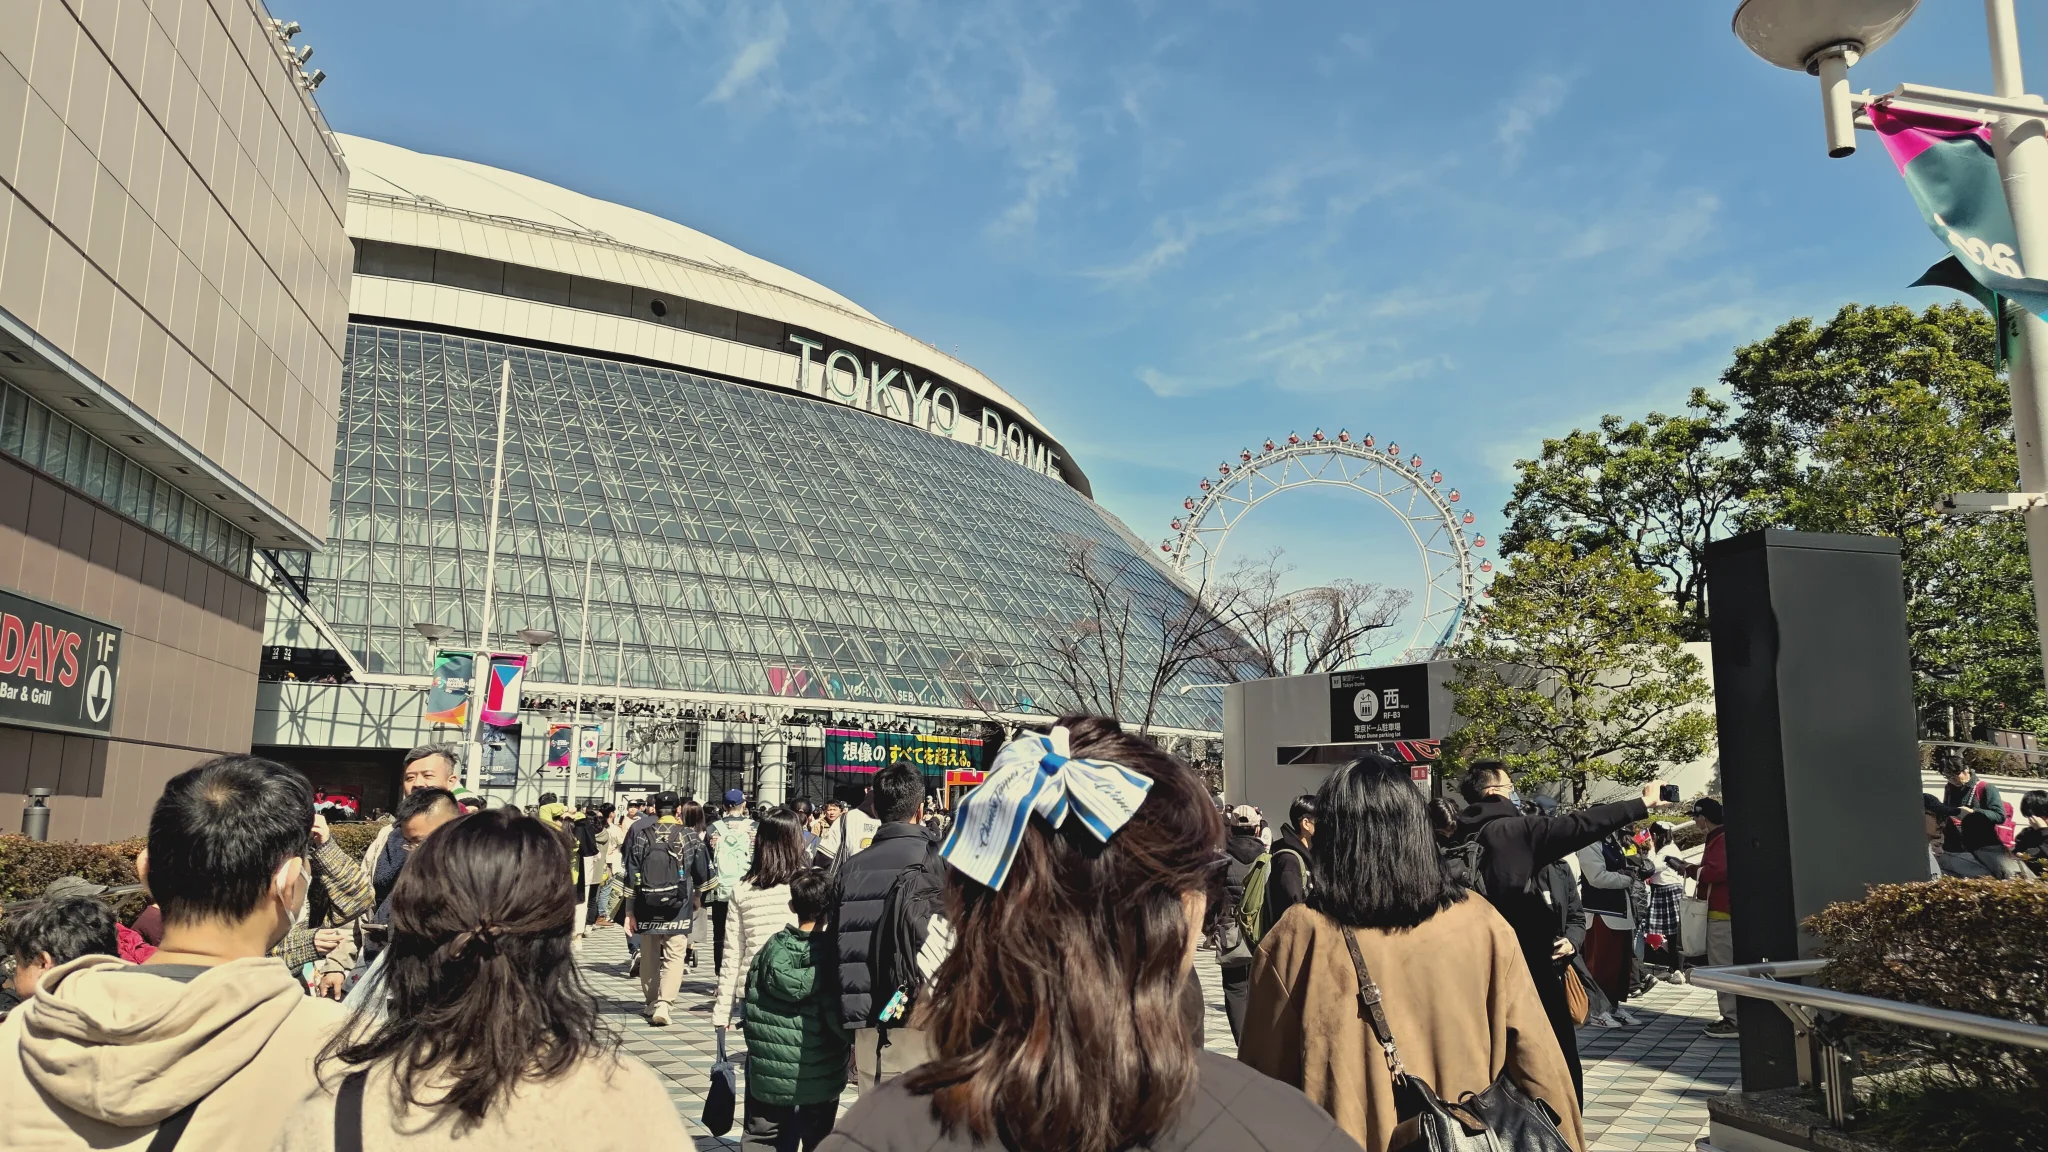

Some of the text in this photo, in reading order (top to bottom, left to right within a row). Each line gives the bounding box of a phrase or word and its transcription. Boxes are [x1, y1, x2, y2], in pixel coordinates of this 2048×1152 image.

[790, 334, 1061, 477] TOKYO DOME
[0, 612, 82, 688] DAYS
[96, 631, 116, 663] 1F
[0, 682, 52, 706] Bar & Grill
[1383, 688, 1400, 710] 西
[1383, 711, 1401, 719] RF-B3
[1354, 722, 1401, 733] 東京ドーム駐車場
